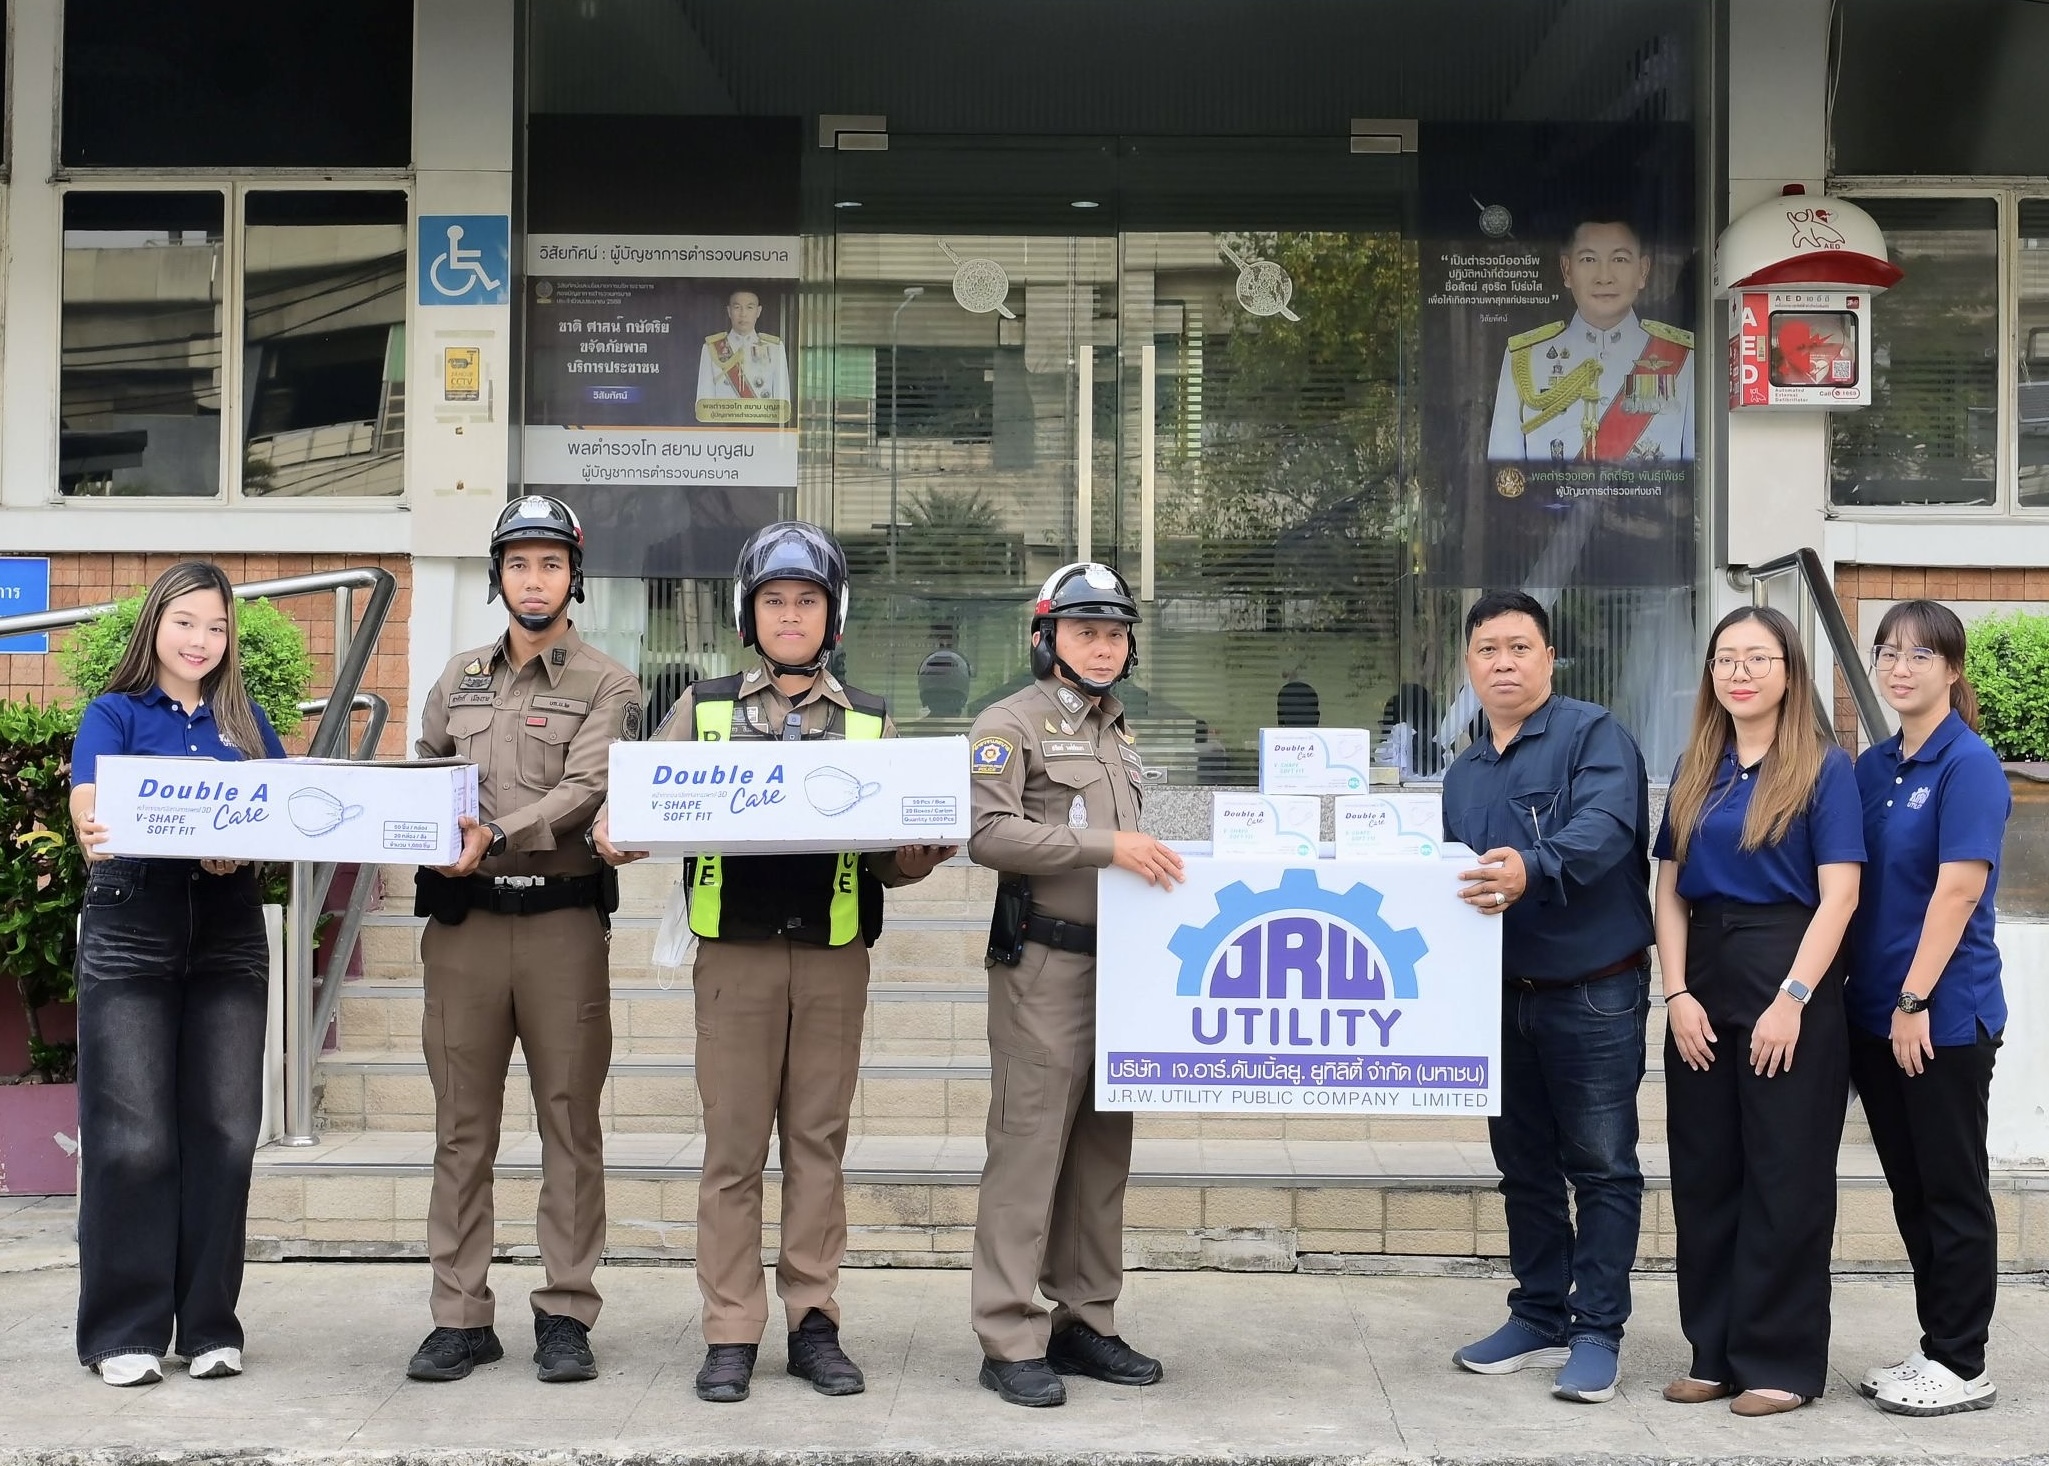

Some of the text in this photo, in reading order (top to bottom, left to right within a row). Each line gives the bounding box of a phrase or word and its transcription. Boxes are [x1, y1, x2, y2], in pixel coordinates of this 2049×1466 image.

[540, 245, 598, 260] วิสัยทัศน์
[610, 245, 788, 264] ผู้บัญชาการตำรวจนครบาล
[1449, 267, 1539, 281] ปฏิบัติหน้าที่ด้วยความ
[1445, 280, 1543, 293] ซื่อสัตย์ สุจริต โปร่งใส
[559, 316, 673, 334] ชาติ ศาสน์ กษัตริย์
[580, 339, 648, 354] ขจัดภัยพาล
[567, 360, 660, 374] บริการประชาชน
[593, 390, 628, 400] วิสัยทัศน์
[568, 437, 755, 462] พลตำรวจโท สยาม บุญสม
[582, 465, 739, 482] ผู้บัญชาการตำรวจนครบาล
[1556, 485, 1662, 498] ผู้บัญชาการตำรวจแห่งชาติ
[1297, 752, 1314, 761] Care
[652, 764, 784, 784] Double A
[138, 778, 268, 803] Double A
[651, 800, 702, 810] V-SHAPE
[729, 786, 787, 814] Care
[136, 812, 186, 824] V-SHAPE
[213, 803, 270, 831] Care
[663, 812, 713, 821] SOFT FIT
[1223, 810, 1254, 818] Double
[1345, 812, 1386, 820] Double A
[147, 825, 196, 835] SOFT FIT
[1209, 916, 1385, 1001] JRW
[1192, 1006, 1402, 1048] UTILITY
[1110, 1056, 1485, 1086] บริษัท เจ.อาร์.ดับเบิ้ลยู. ยูทิลิตี้ จำกัด (มหาชน)
[1108, 1089, 1488, 1108] J.R.W. UTILITY PUBLIC COMPANY LIMITED
